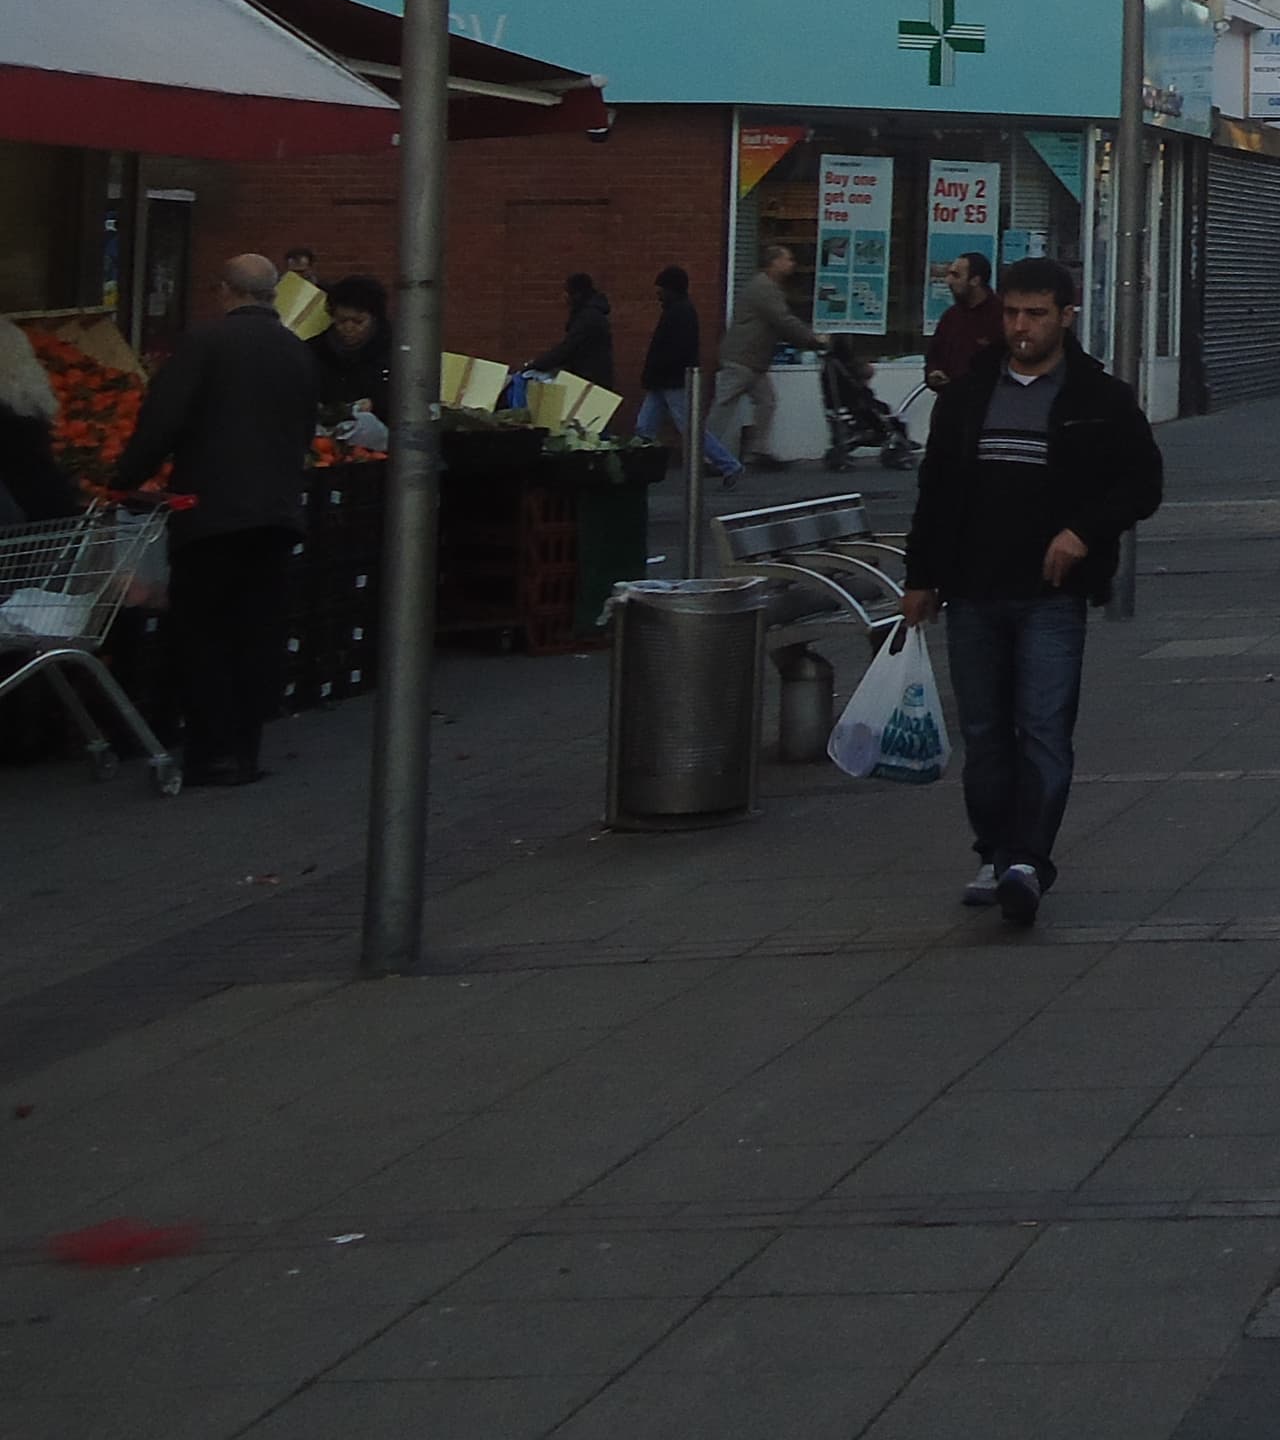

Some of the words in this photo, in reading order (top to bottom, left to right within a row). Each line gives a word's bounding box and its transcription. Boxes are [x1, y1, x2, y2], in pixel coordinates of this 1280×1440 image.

[824, 170, 849, 187] Buy
[853, 174, 877, 187] one
[934, 177, 969, 201] Any
[975, 179, 986, 199] 2
[824, 191, 845, 206] get
[848, 192, 872, 205] one
[824, 209, 849, 222] free
[933, 203, 959, 223] for
[964, 204, 987, 224] £5
